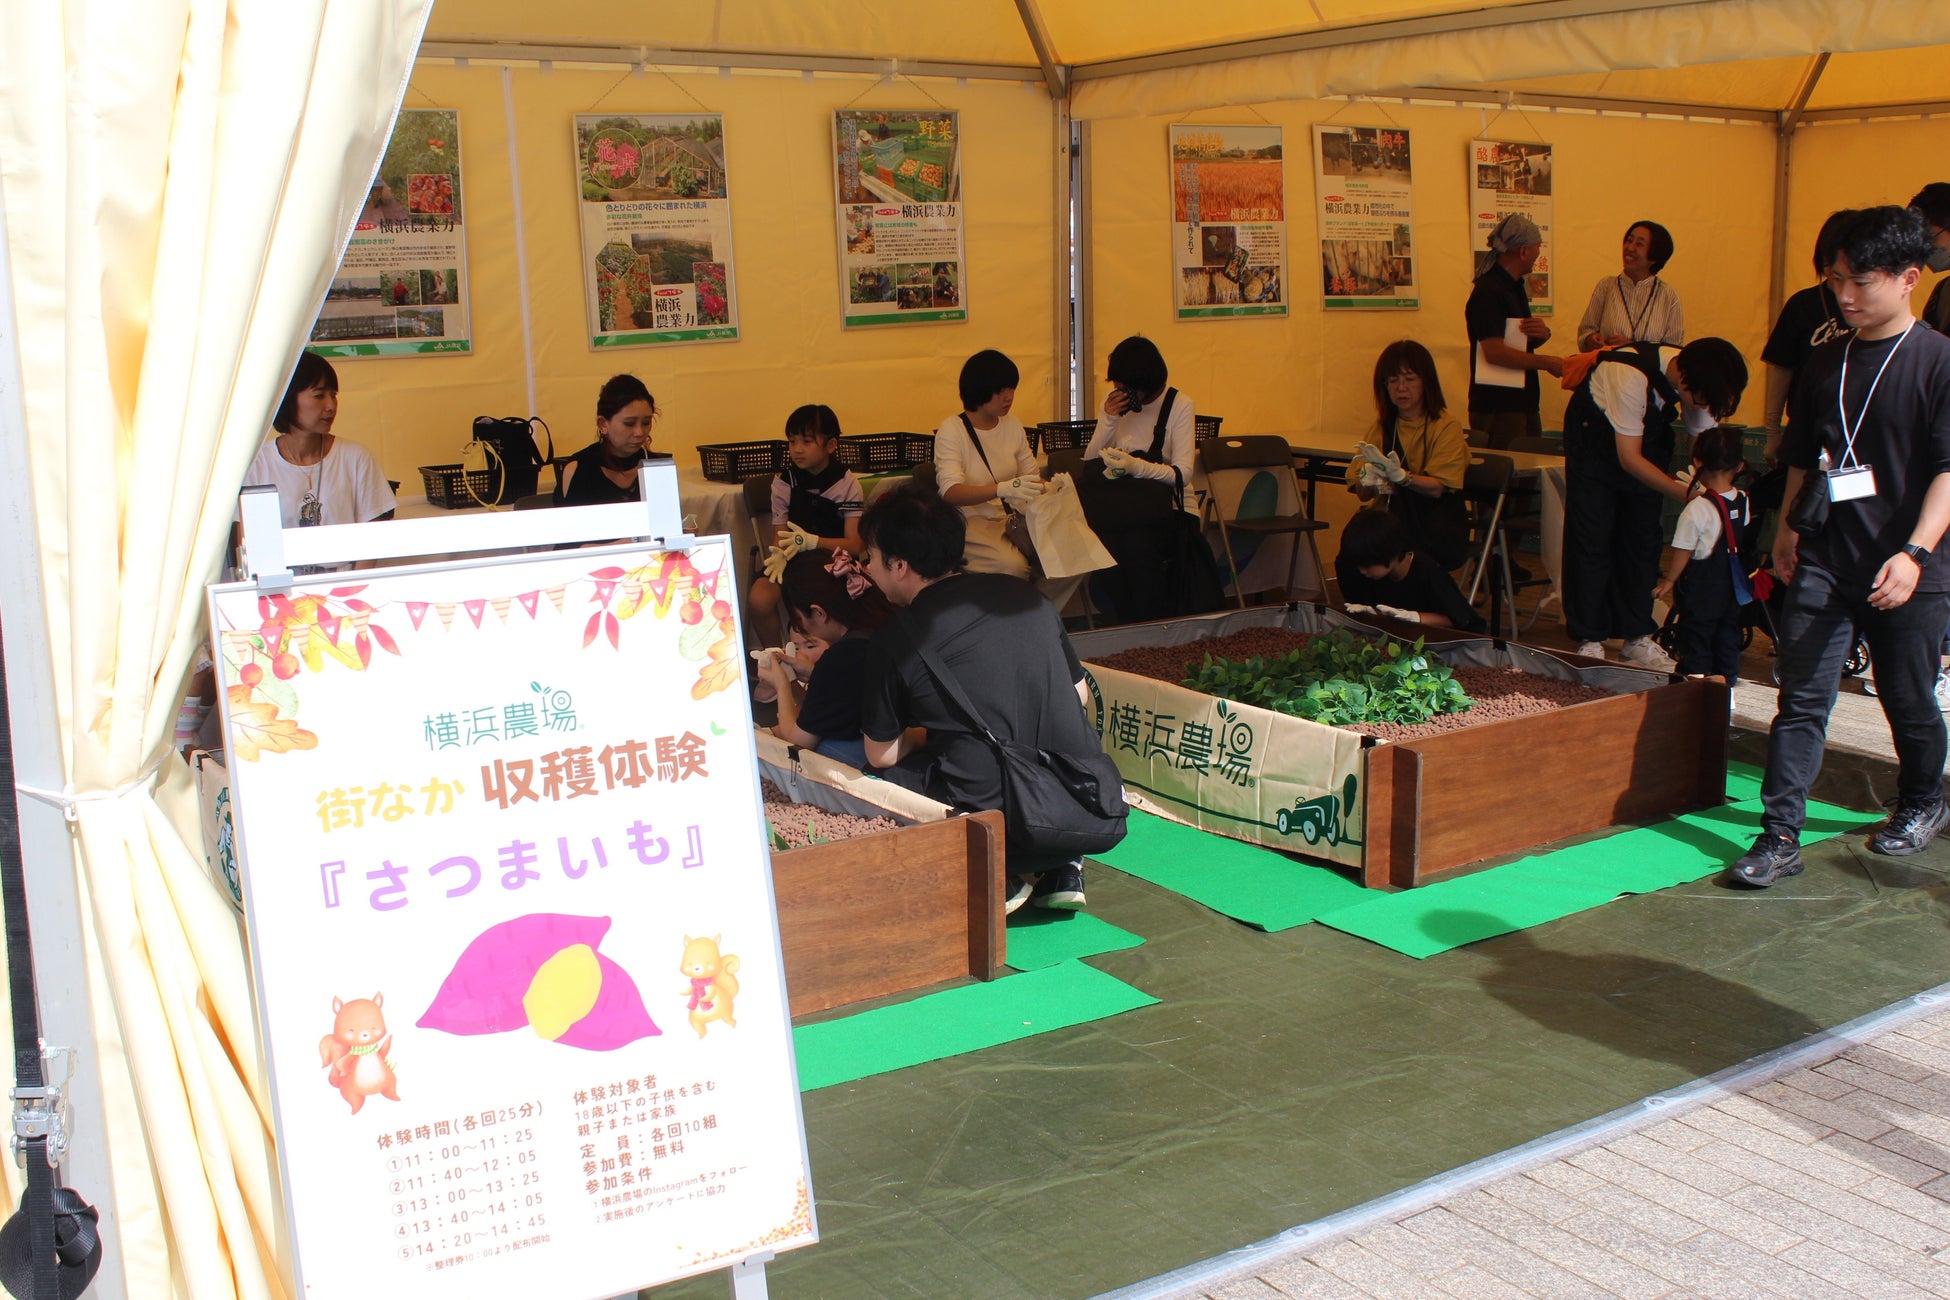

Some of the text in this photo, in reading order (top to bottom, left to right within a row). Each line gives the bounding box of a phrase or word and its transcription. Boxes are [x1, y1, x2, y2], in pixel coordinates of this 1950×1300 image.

[902, 205, 955, 218] 横浜農業力
[1326, 202, 1369, 215] 横浜農業力
[380, 217, 454, 234] 横浜農業力
[655, 298, 681, 312] 横浜
[656, 313, 695, 328] 農業力
[423, 681, 579, 751] 横浜農場
[1108, 699, 1254, 788] 横浜農場
[315, 730, 709, 833] 街なか 収穫体験
[320, 819, 705, 912] 『さつまいも』
[573, 1074, 657, 1107] 体験対象者
[575, 1080, 717, 1122] 18歳以下の子供を含む
[577, 1104, 677, 1137] 親子または家族
[585, 1166, 653, 1195] 参加条件
